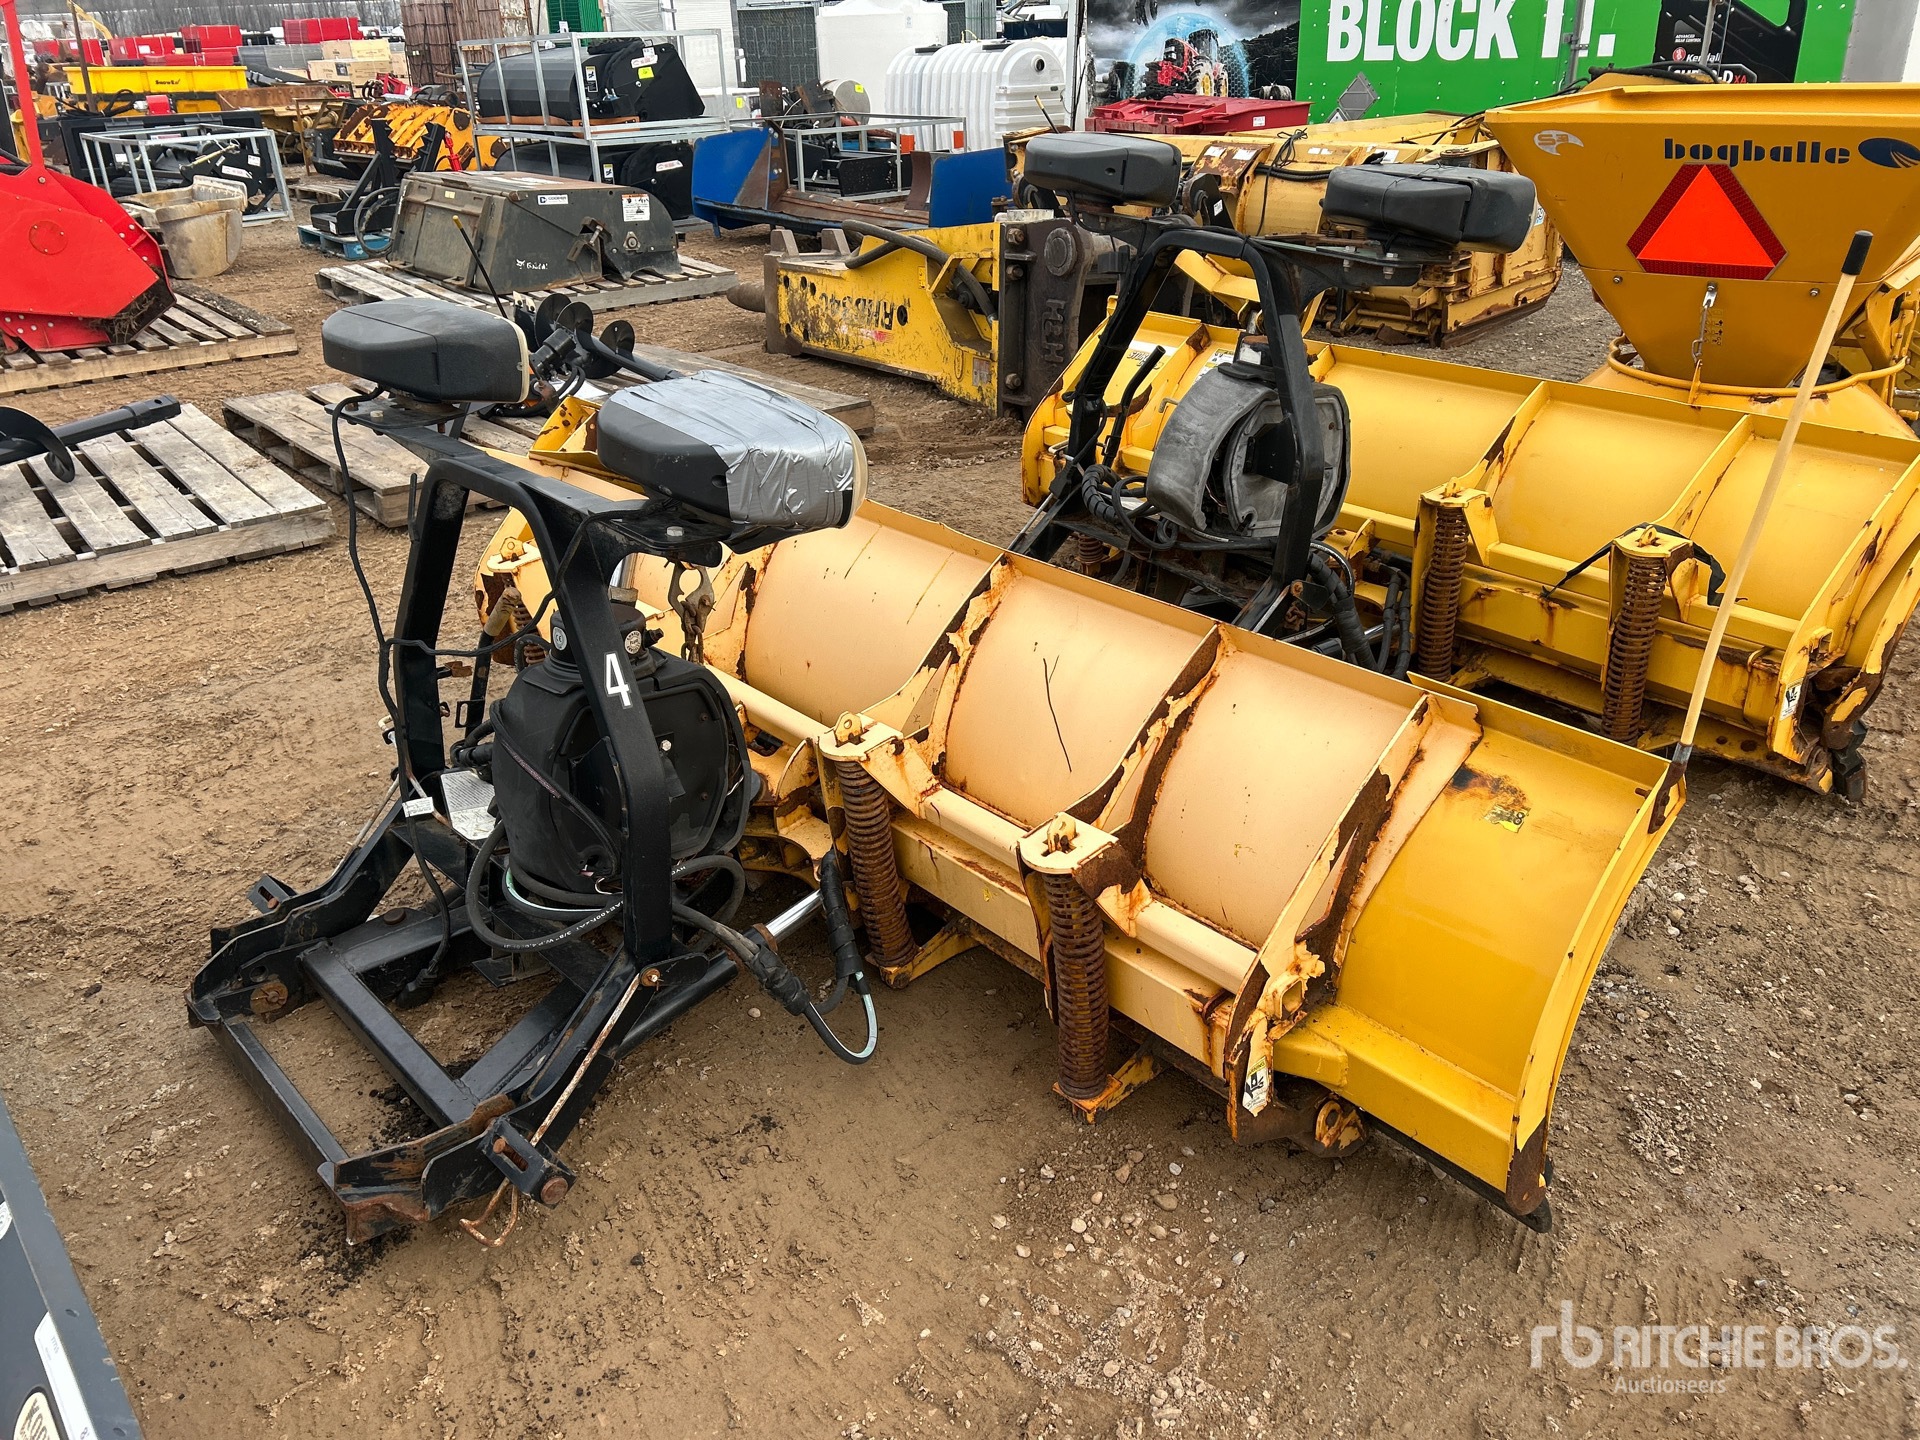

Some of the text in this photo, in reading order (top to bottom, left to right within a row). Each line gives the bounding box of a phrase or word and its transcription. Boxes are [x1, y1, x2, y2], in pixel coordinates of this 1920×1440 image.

[1326, 0, 1519, 62] BLOCK
[1664, 138, 1850, 168] bogballe
[605, 652, 632, 707] 4
